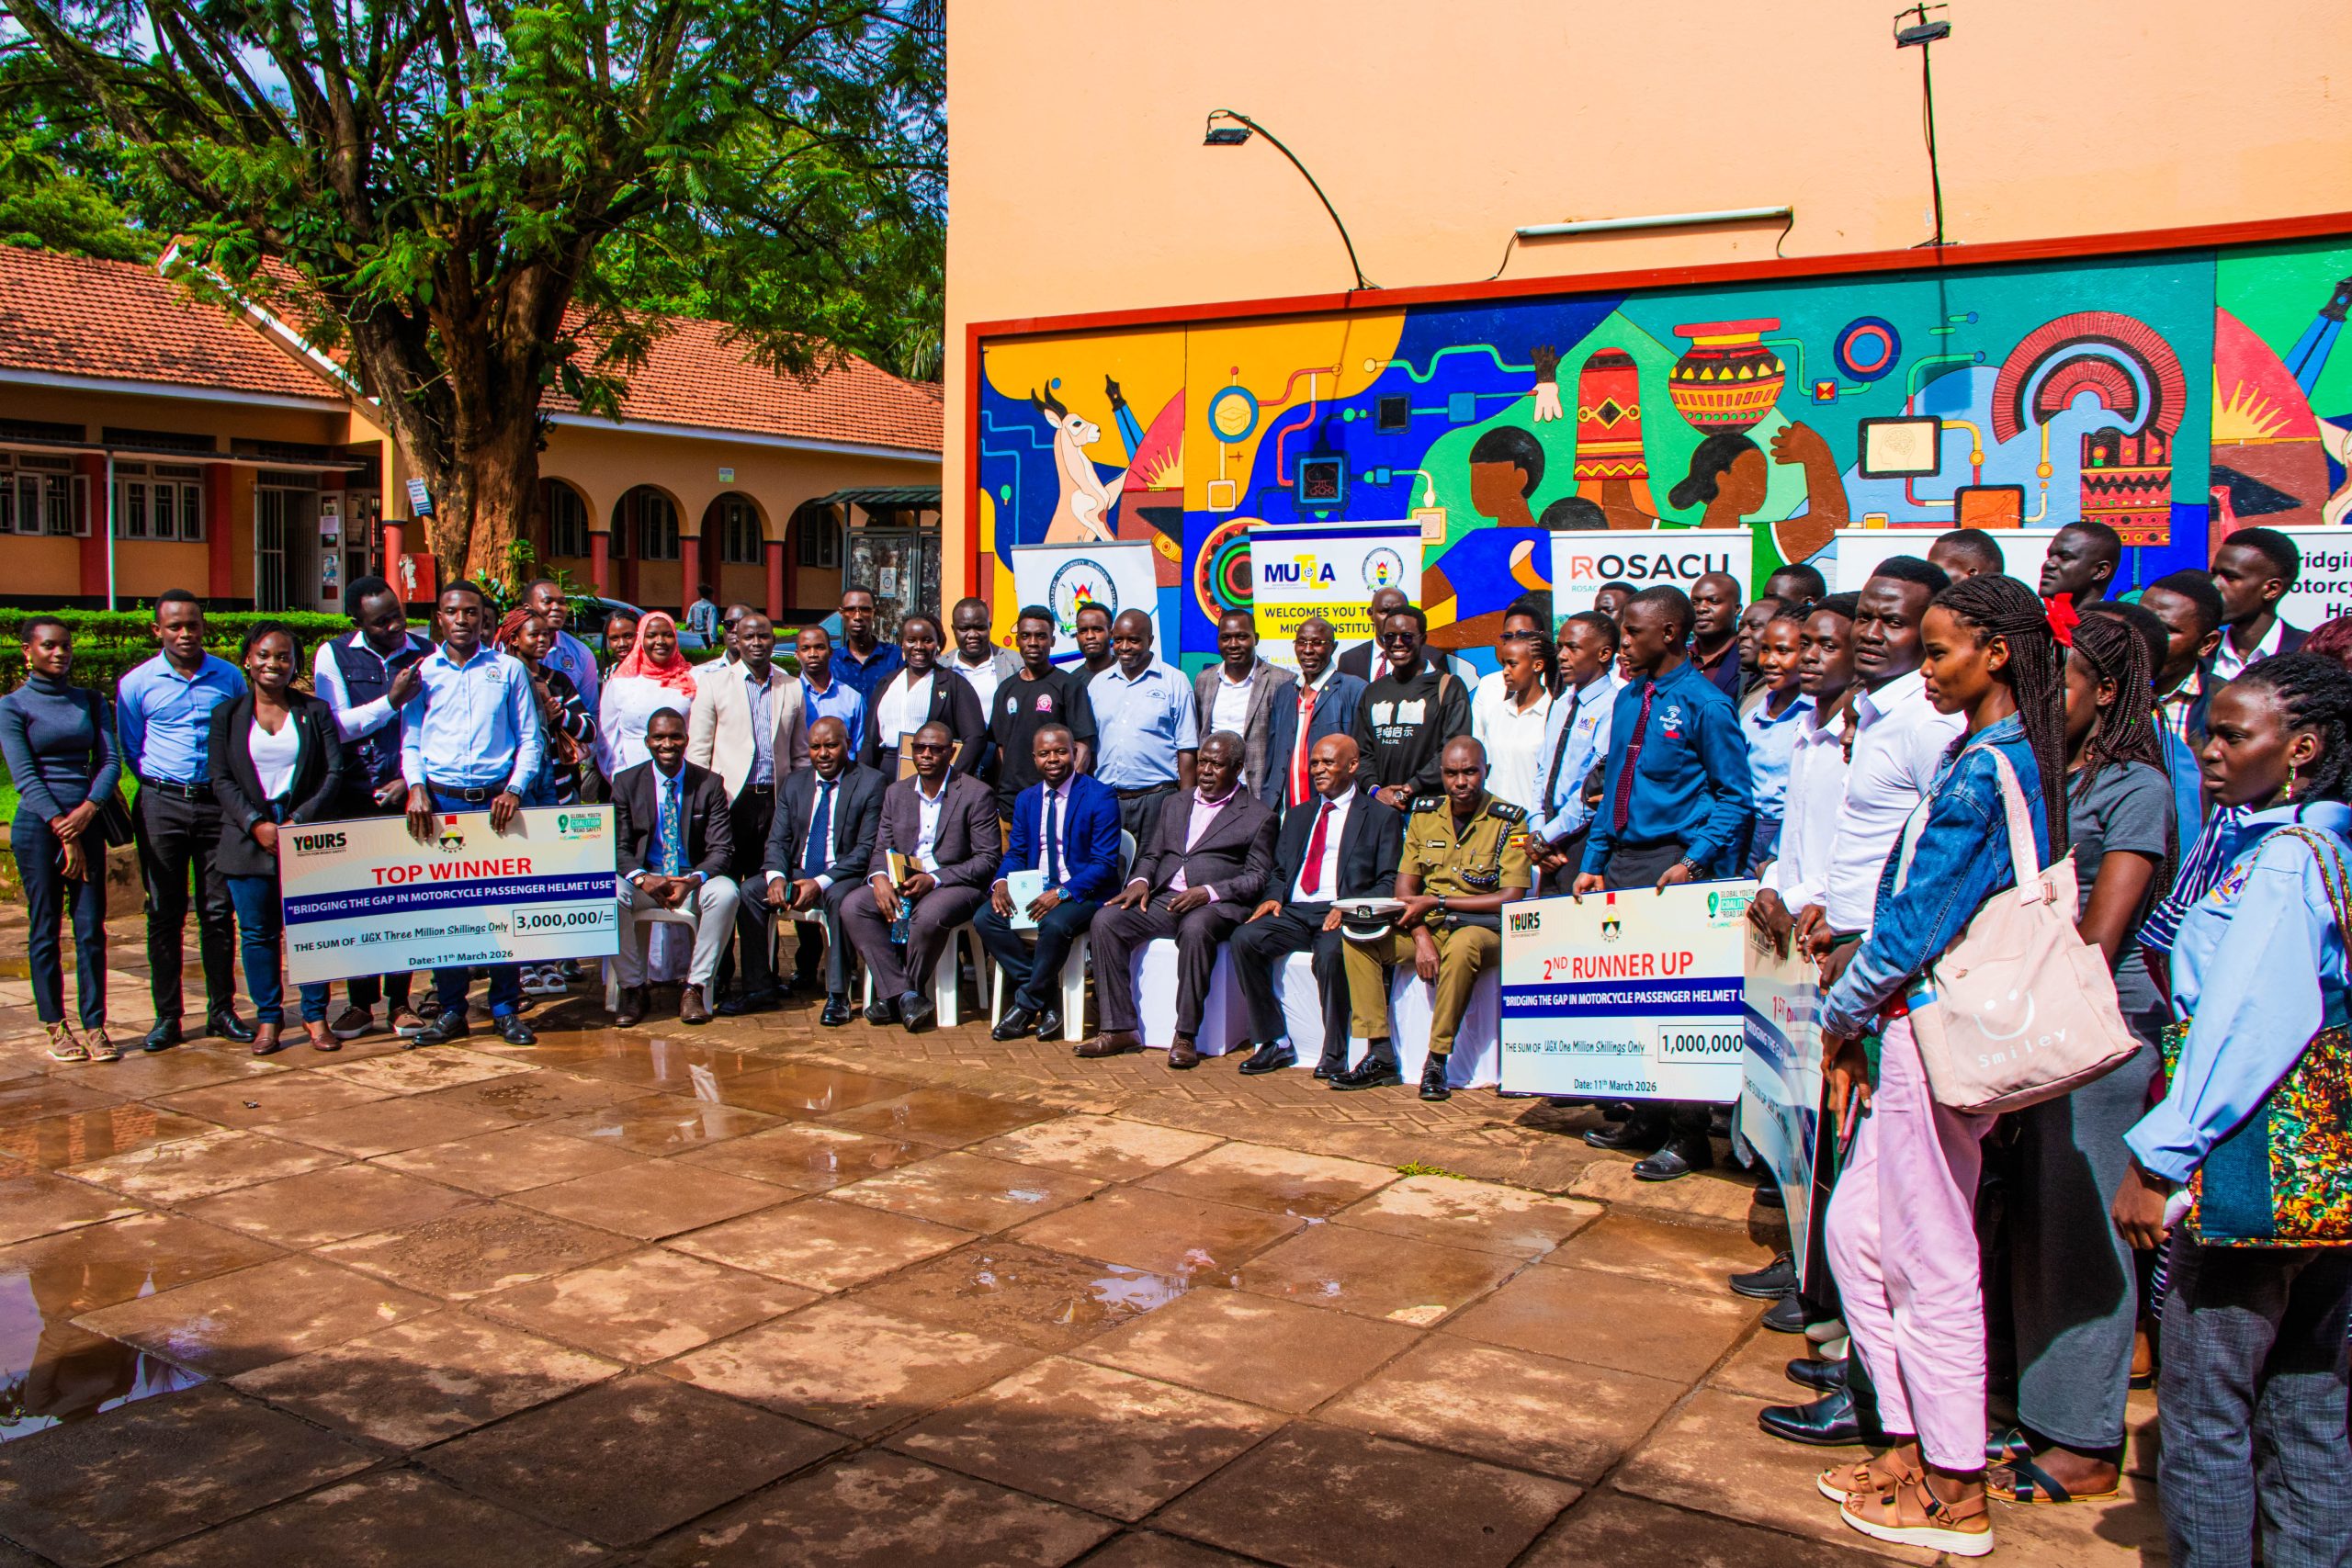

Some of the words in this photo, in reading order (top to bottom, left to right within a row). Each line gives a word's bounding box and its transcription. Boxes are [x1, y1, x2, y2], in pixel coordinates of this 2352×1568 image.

[1057, 559, 1084, 578] UNIVERSITY
[1088, 560, 1110, 581] BUSINESS
[1571, 554, 1729, 580] ROSACU
[2290, 579, 2352, 597] otorc
[1264, 607, 1329, 618] WELCOMES
[1332, 607, 1356, 616] YOU
[1332, 623, 1375, 634] NSTITUT
[571, 818, 600, 827] COALITION
[293, 832, 347, 852] YOURS
[371, 864, 423, 886] TOP
[428, 857, 532, 878] WINNER
[288, 899, 347, 915] "BRIDGING
[349, 897, 370, 908] THE
[372, 896, 395, 906] GAP
[397, 893, 409, 903] IN
[412, 887, 483, 901] MOTORCYCLE
[484, 884, 546, 897] PASSENGER
[548, 881, 589, 893] HELMET
[591, 879, 616, 890] USE"
[1510, 912, 1541, 931] YOURS
[294, 942, 315, 953] THE
[317, 939, 340, 950] SUM
[342, 937, 356, 947] OF
[361, 932, 382, 943] UGX
[384, 931, 413, 942] Three
[414, 927, 446, 937] Million
[447, 923, 486, 935] Shillings
[488, 922, 509, 932] Only
[516, 910, 615, 930] 3,000,000/=
[409, 957, 435, 966] Date:
[458, 952, 488, 962] March
[490, 950, 514, 959] 2026
[1544, 956, 1568, 980] 2ND
[1573, 953, 1655, 979] RUNNER
[1661, 951, 1693, 976] UP
[1539, 994, 1552, 1005] THE
[1553, 994, 1568, 1005] GAP
[1569, 994, 1577, 1005] IN
[1578, 992, 1634, 1004] MOTORCYCLE
[1634, 990, 1690, 1003] PASSENGER
[1692, 989, 1737, 1002] HELMET
[1505, 1043, 1517, 1052] THE
[1518, 1043, 1532, 1052] SUM
[1532, 1043, 1541, 1052] OF
[1544, 1041, 1557, 1052] UGX
[1558, 1041, 1571, 1052] One
[1573, 1040, 1594, 1052] Million
[1596, 1040, 1626, 1055] Shillings
[1628, 1040, 1645, 1054] Only
[1977, 1027, 2067, 1068] Smiley
[1574, 1079, 1592, 1089] Date:
[1609, 1080, 1634, 1091] March
[1635, 1081, 1657, 1092] 2026
